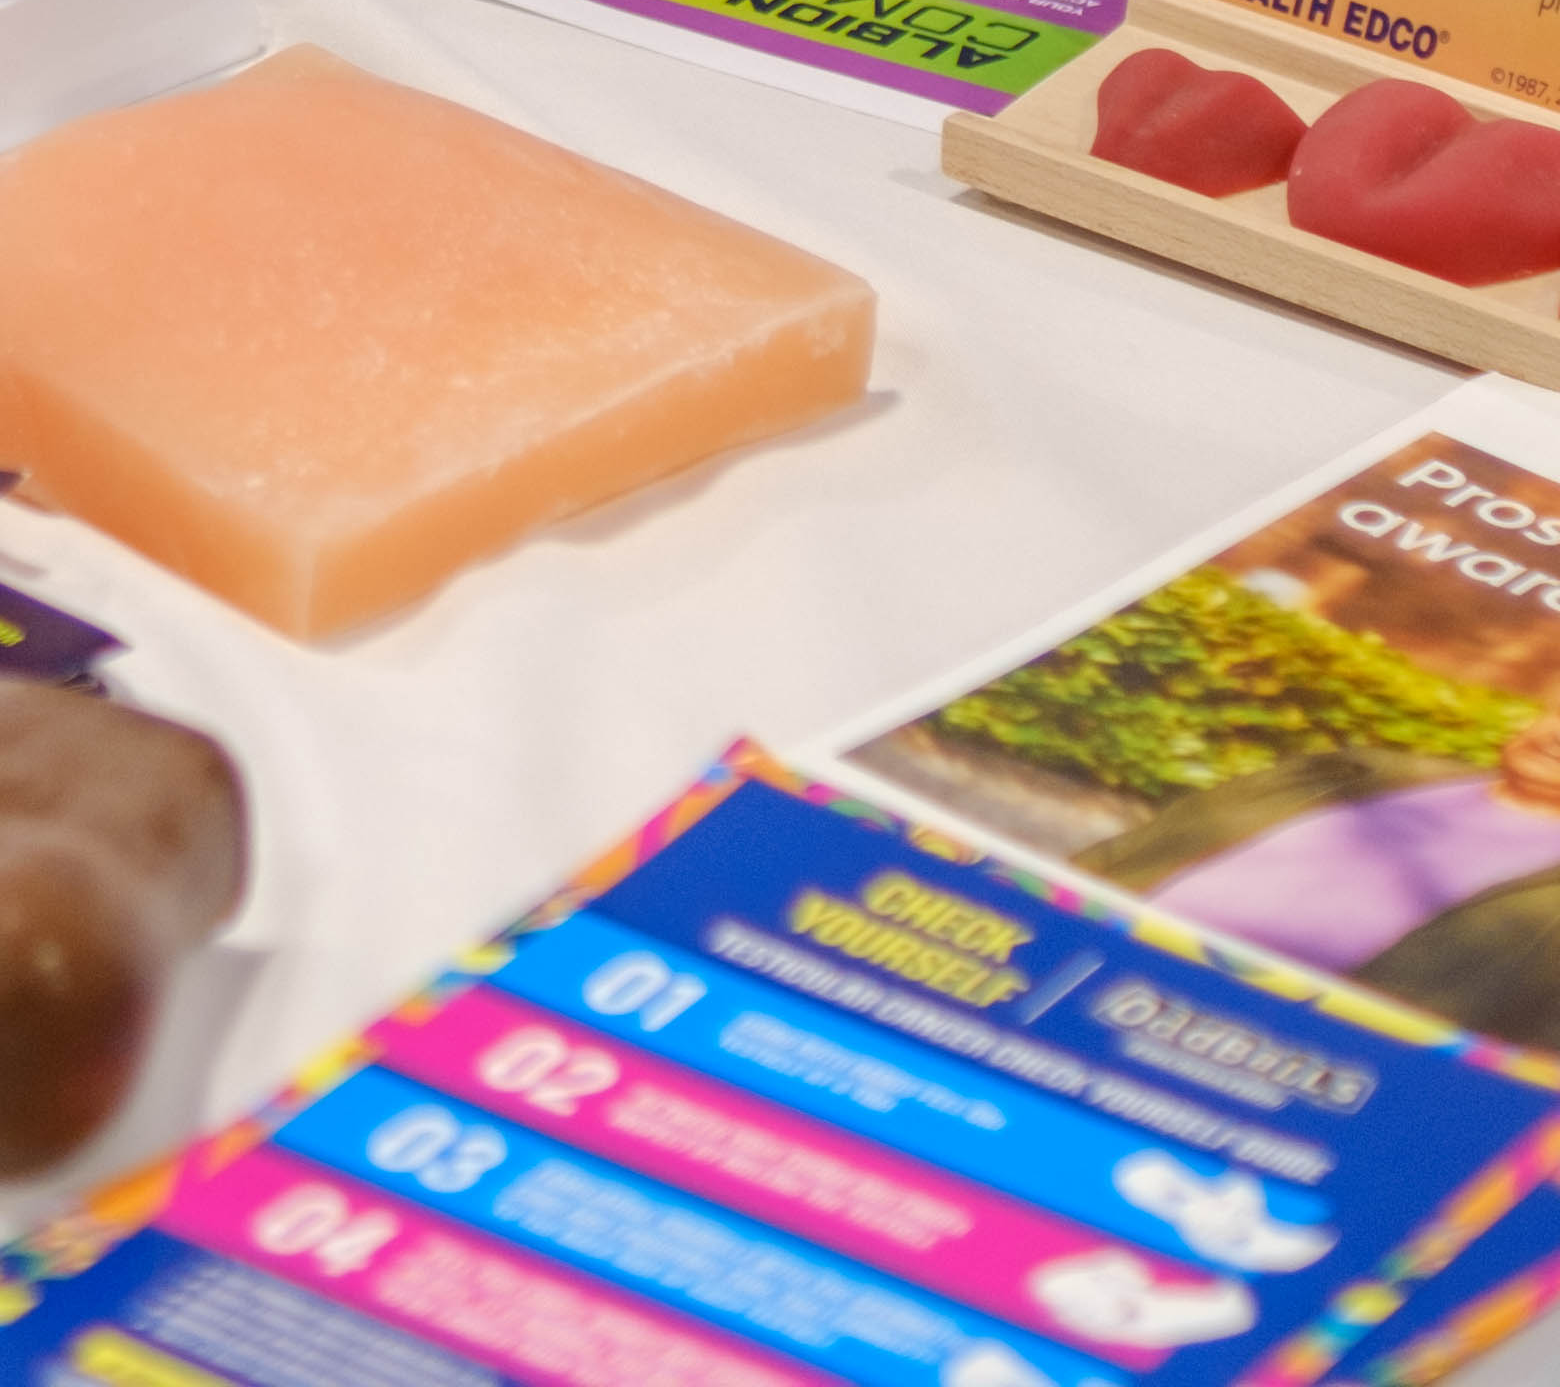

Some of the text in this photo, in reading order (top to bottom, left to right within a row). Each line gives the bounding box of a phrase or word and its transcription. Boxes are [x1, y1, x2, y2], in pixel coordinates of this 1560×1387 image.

[786, 886, 1032, 1010] YOURSELF
[860, 869, 1035, 966] CHECK
[581, 949, 708, 1033] 01
[474, 1024, 621, 1117] 02
[365, 1104, 508, 1194] 03
[250, 1182, 399, 1271] 04
